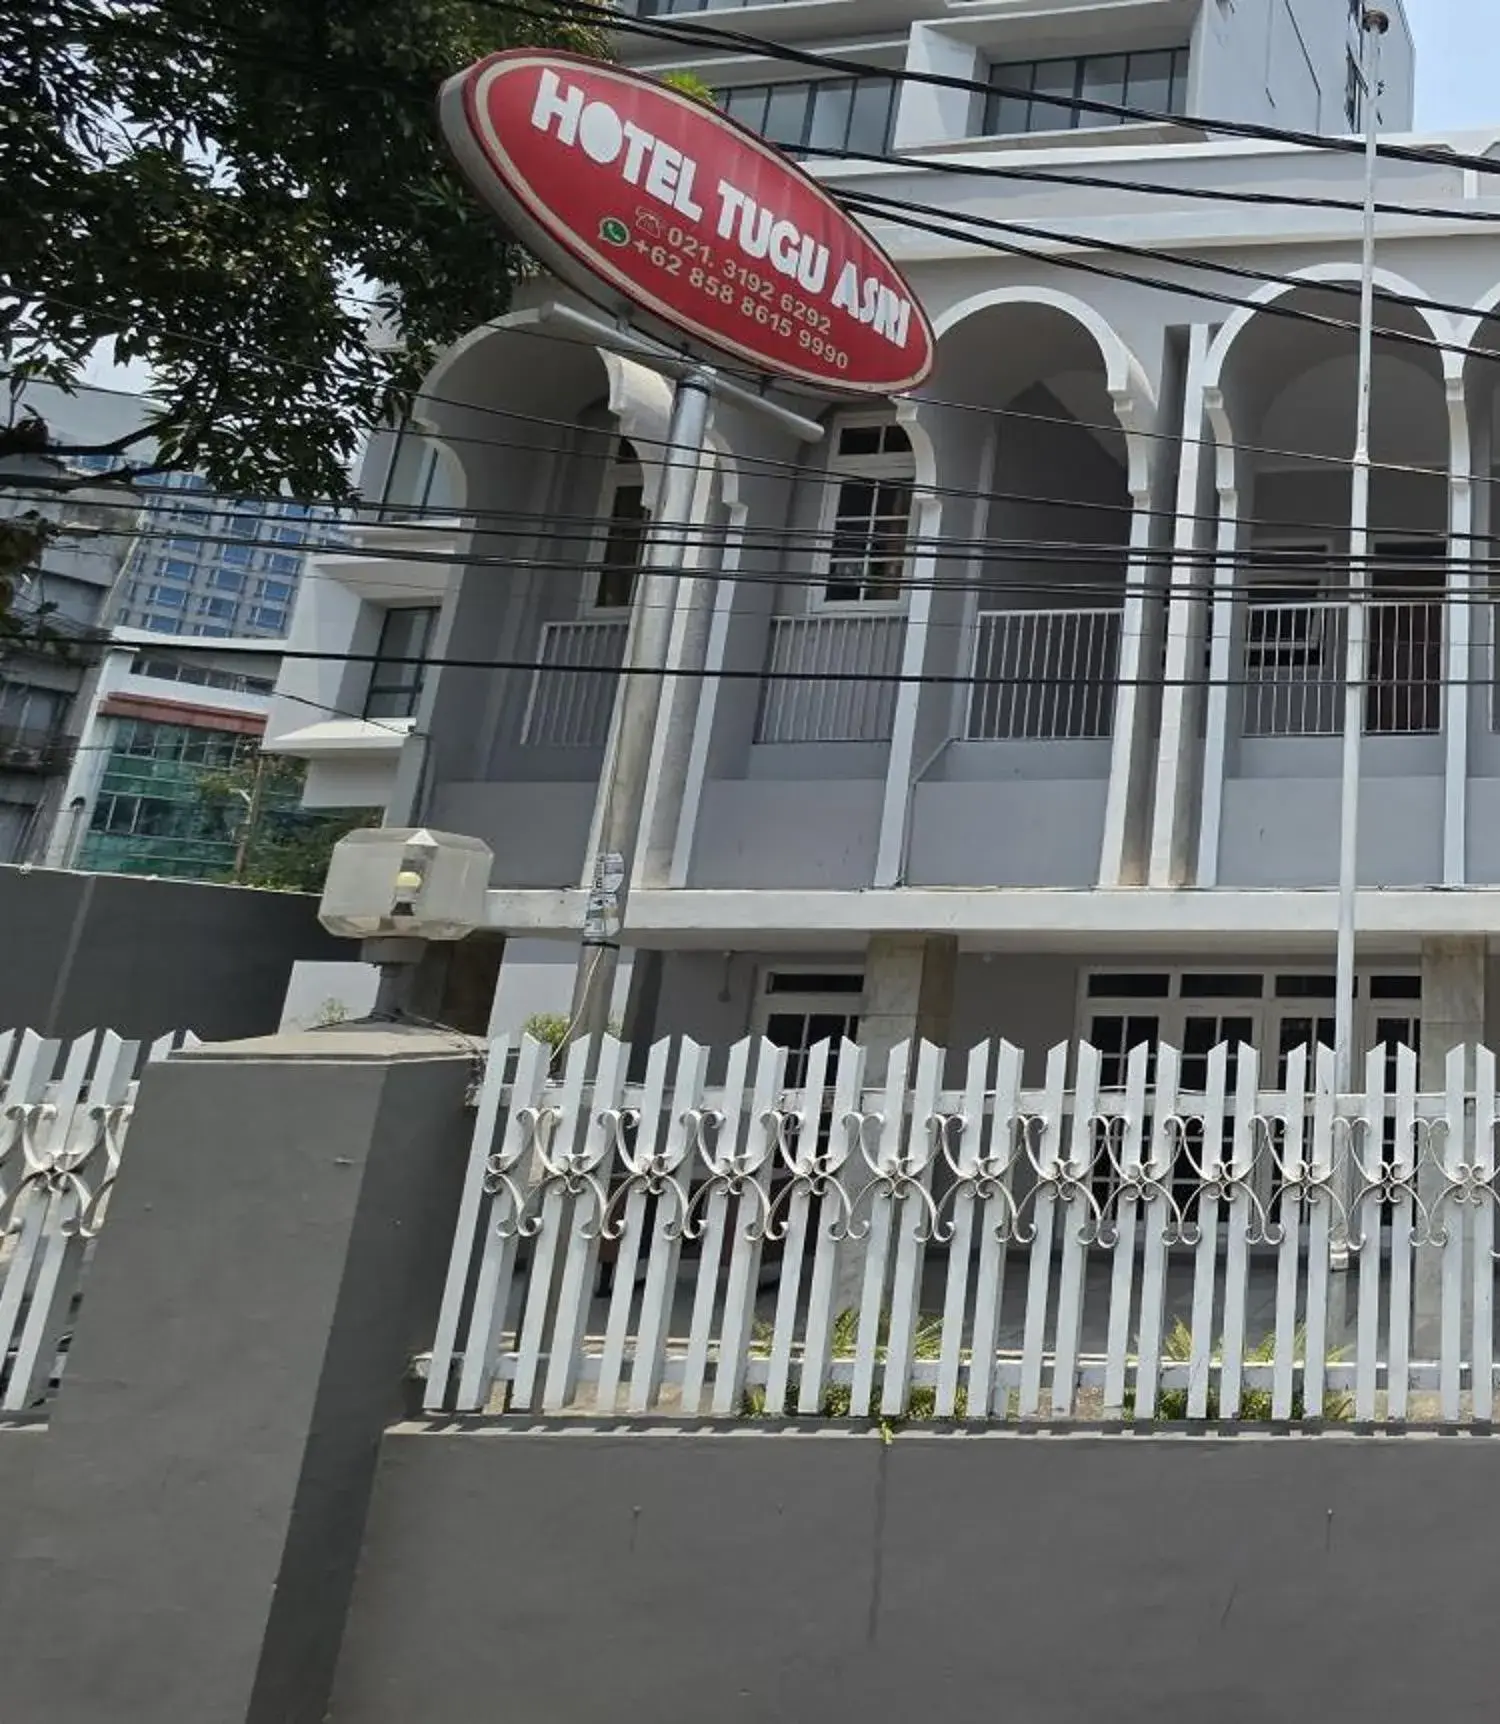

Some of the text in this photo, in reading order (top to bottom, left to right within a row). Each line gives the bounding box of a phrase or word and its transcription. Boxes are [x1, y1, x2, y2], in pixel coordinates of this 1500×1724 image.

[531, 68, 913, 349] HOTEL TUGU ASRI
[632, 239, 848, 369] +62 858 8615 9990
[667, 227, 831, 335] 021. 3192 6292
